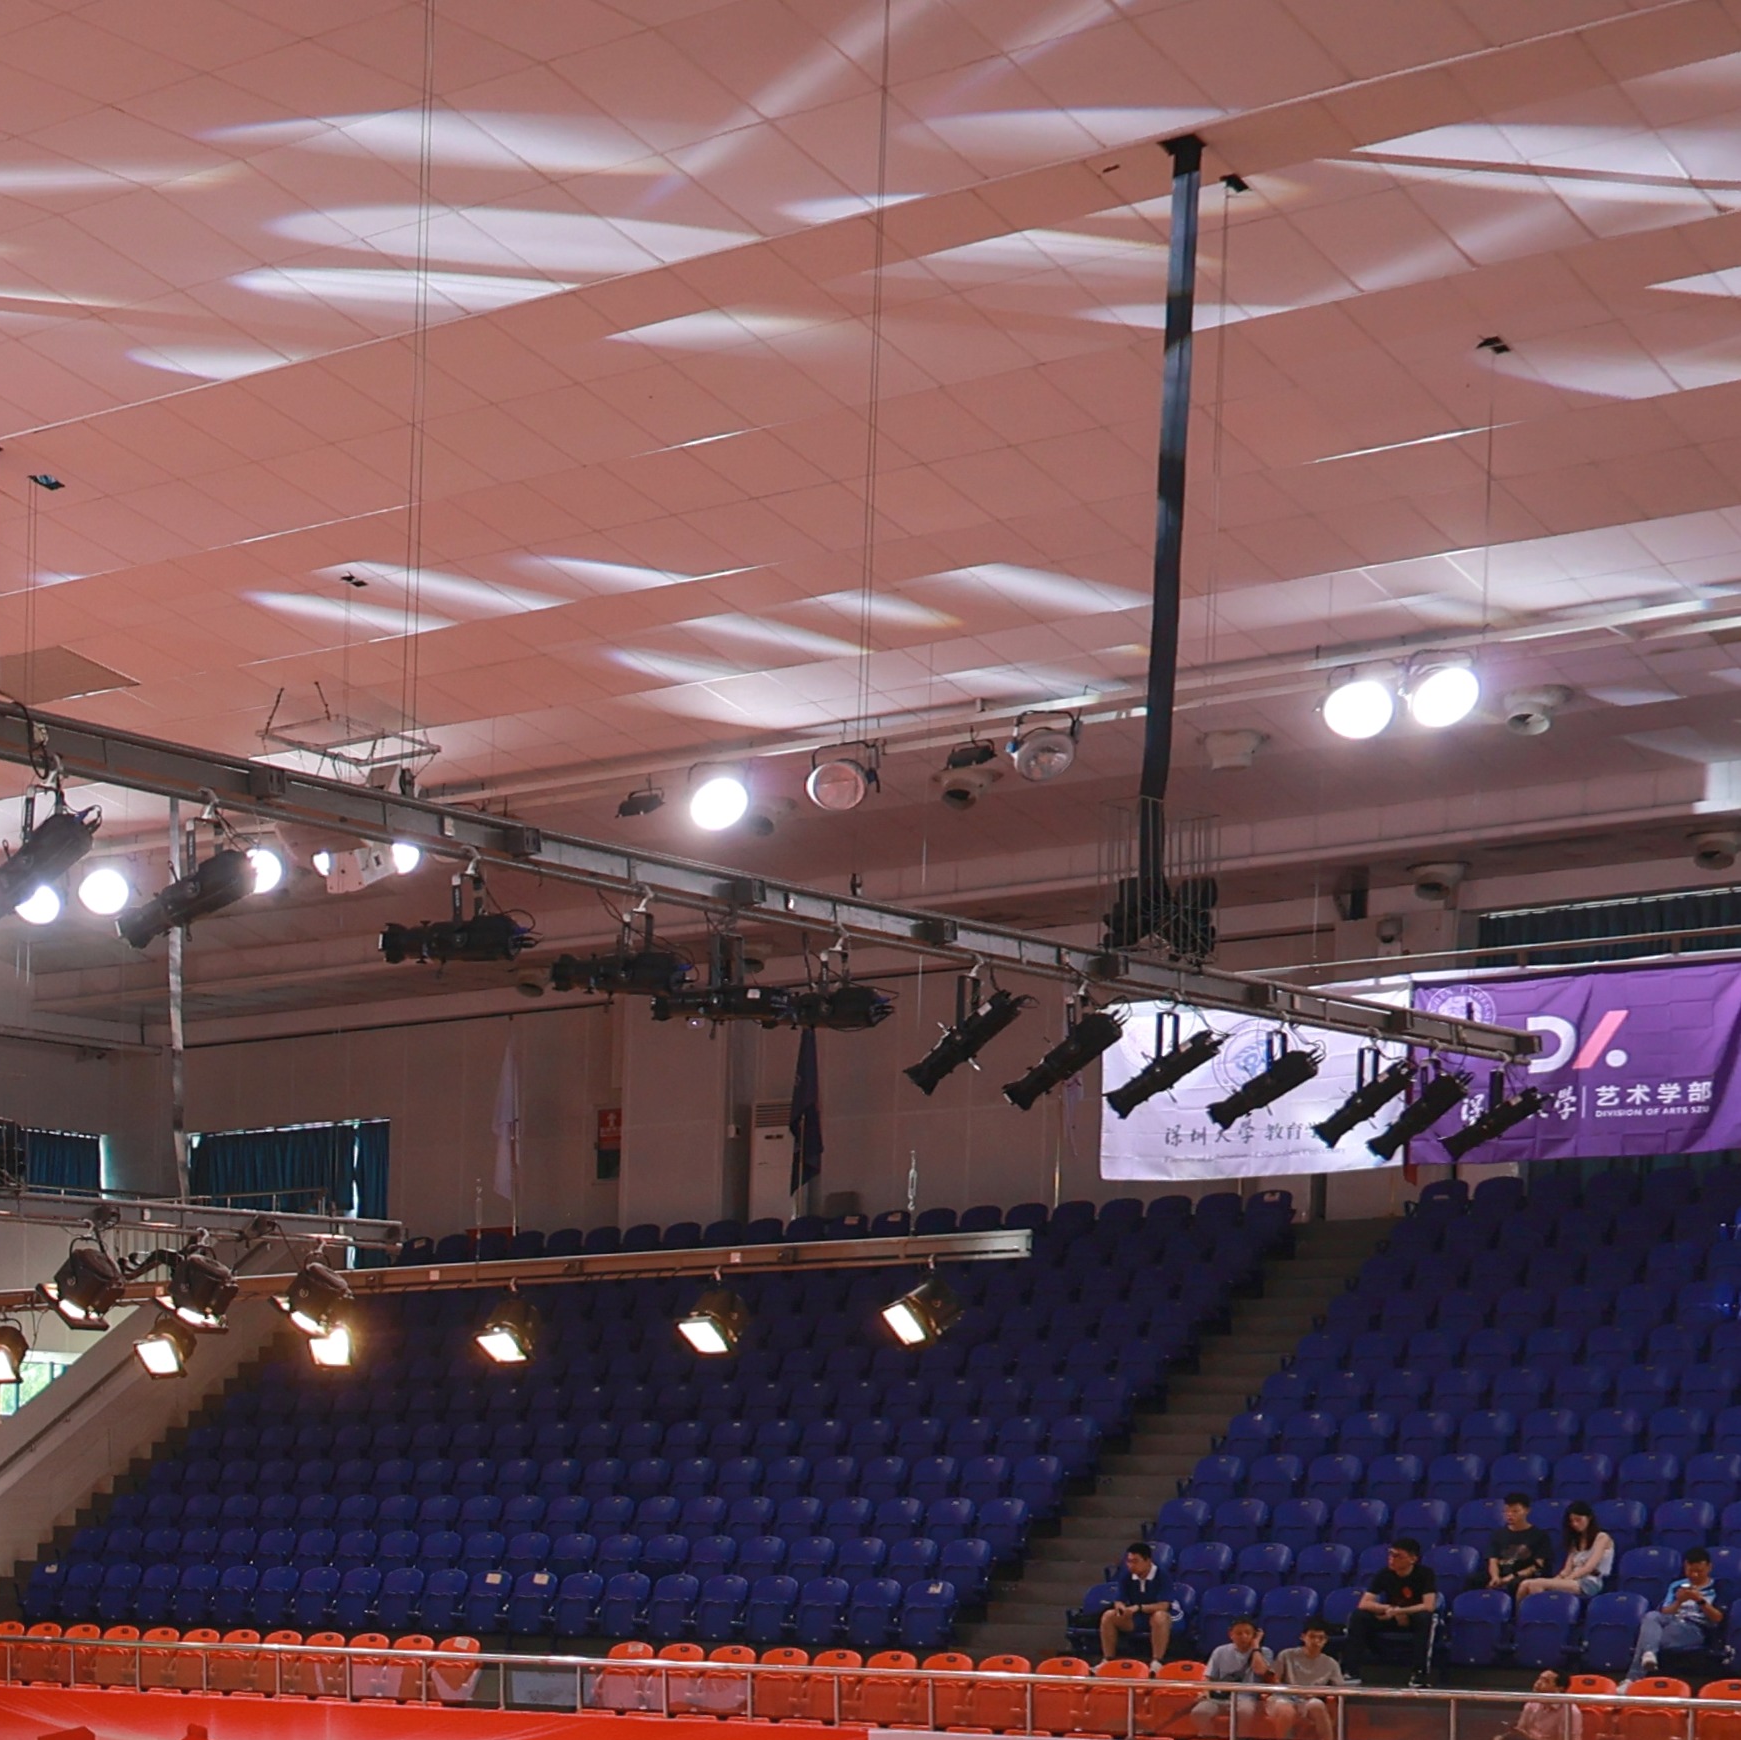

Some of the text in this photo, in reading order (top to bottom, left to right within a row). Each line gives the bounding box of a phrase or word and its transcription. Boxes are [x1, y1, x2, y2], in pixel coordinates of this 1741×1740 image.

[1595, 1081, 1713, 1107] 艺术学部
[1595, 1108, 1643, 1118] DIVISION
[1645, 1107, 1660, 1116] OF
